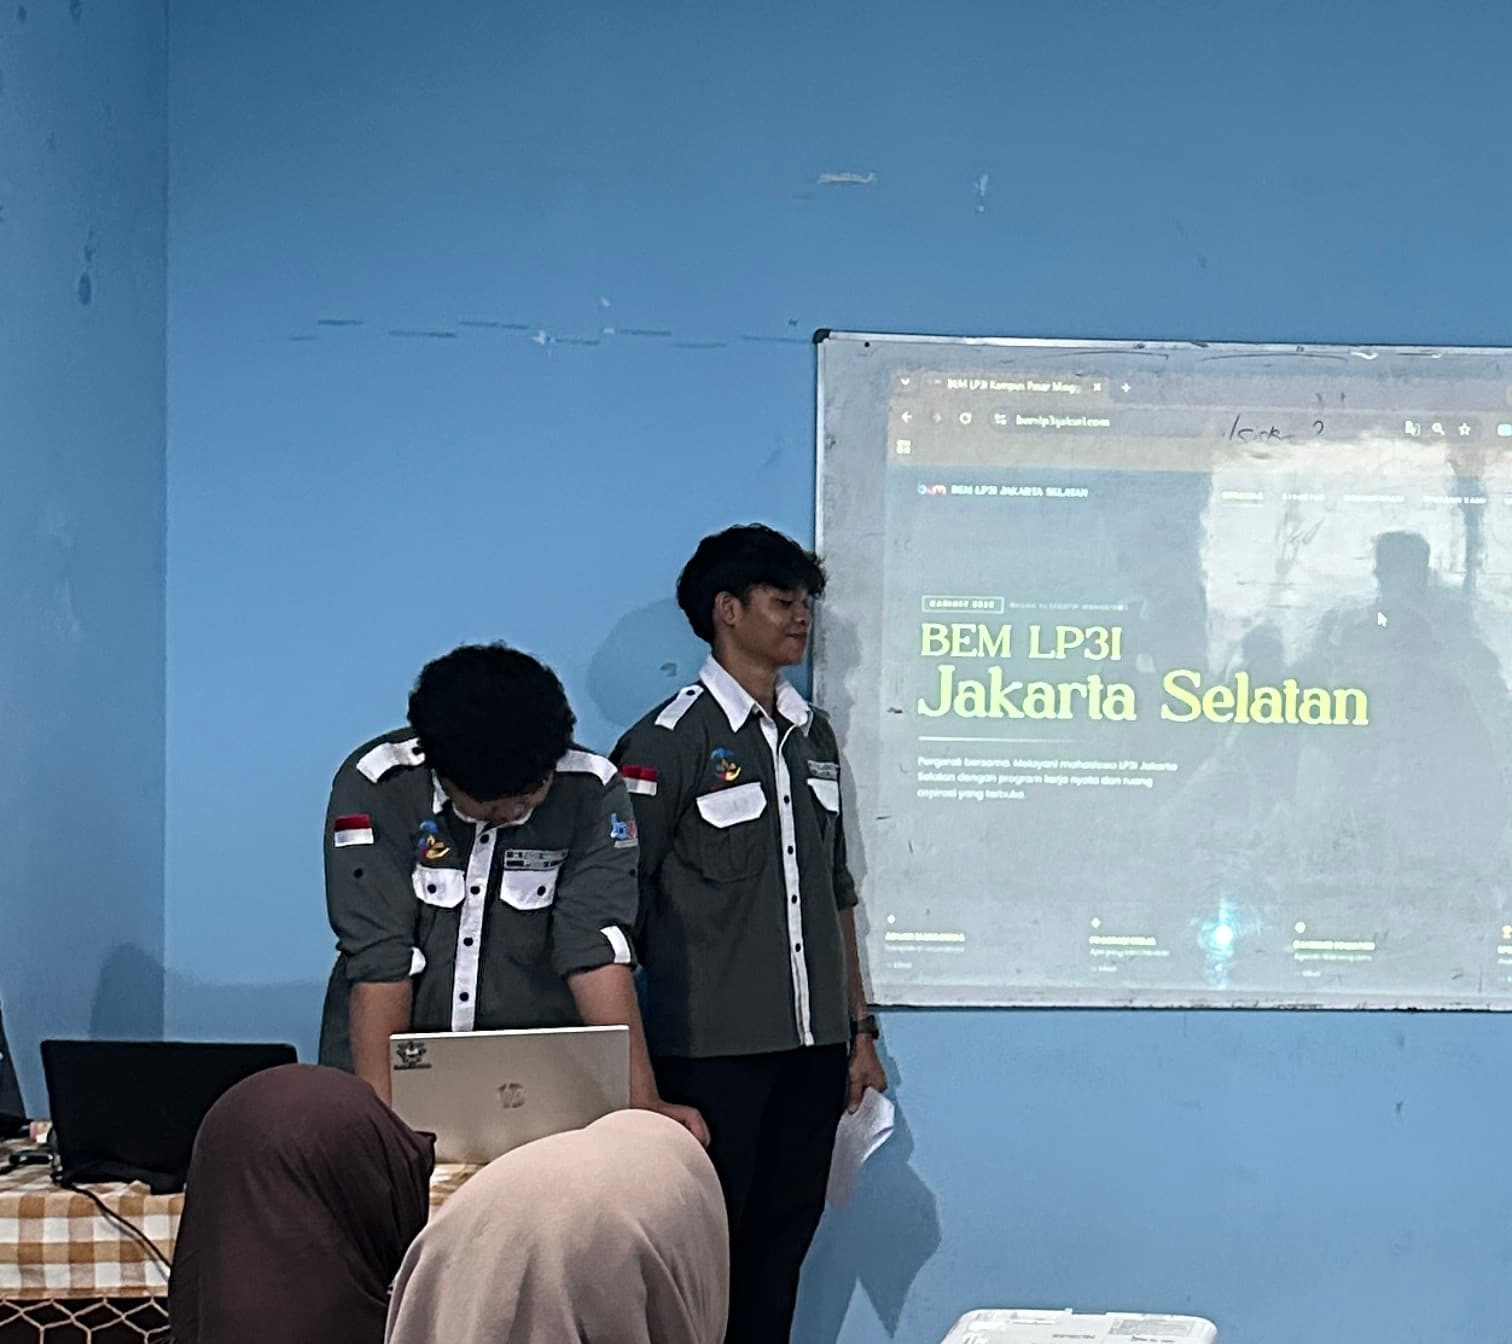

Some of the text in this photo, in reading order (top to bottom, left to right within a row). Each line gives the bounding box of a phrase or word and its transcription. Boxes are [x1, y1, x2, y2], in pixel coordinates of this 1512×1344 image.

[951, 484, 973, 495] BEM
[999, 486, 1043, 497] JAKARTA
[1045, 487, 1088, 498] SELATAN
[920, 622, 1122, 660] BEM LP3I
[917, 664, 1369, 726] Jakarta Selatan
[1139, 760, 1178, 772] Jakarta
[957, 772, 997, 785] dengan
[998, 774, 1042, 785] program
[1101, 775, 1121, 785] dan
[1122, 776, 1153, 788] ruang
[958, 789, 984, 801] yang
